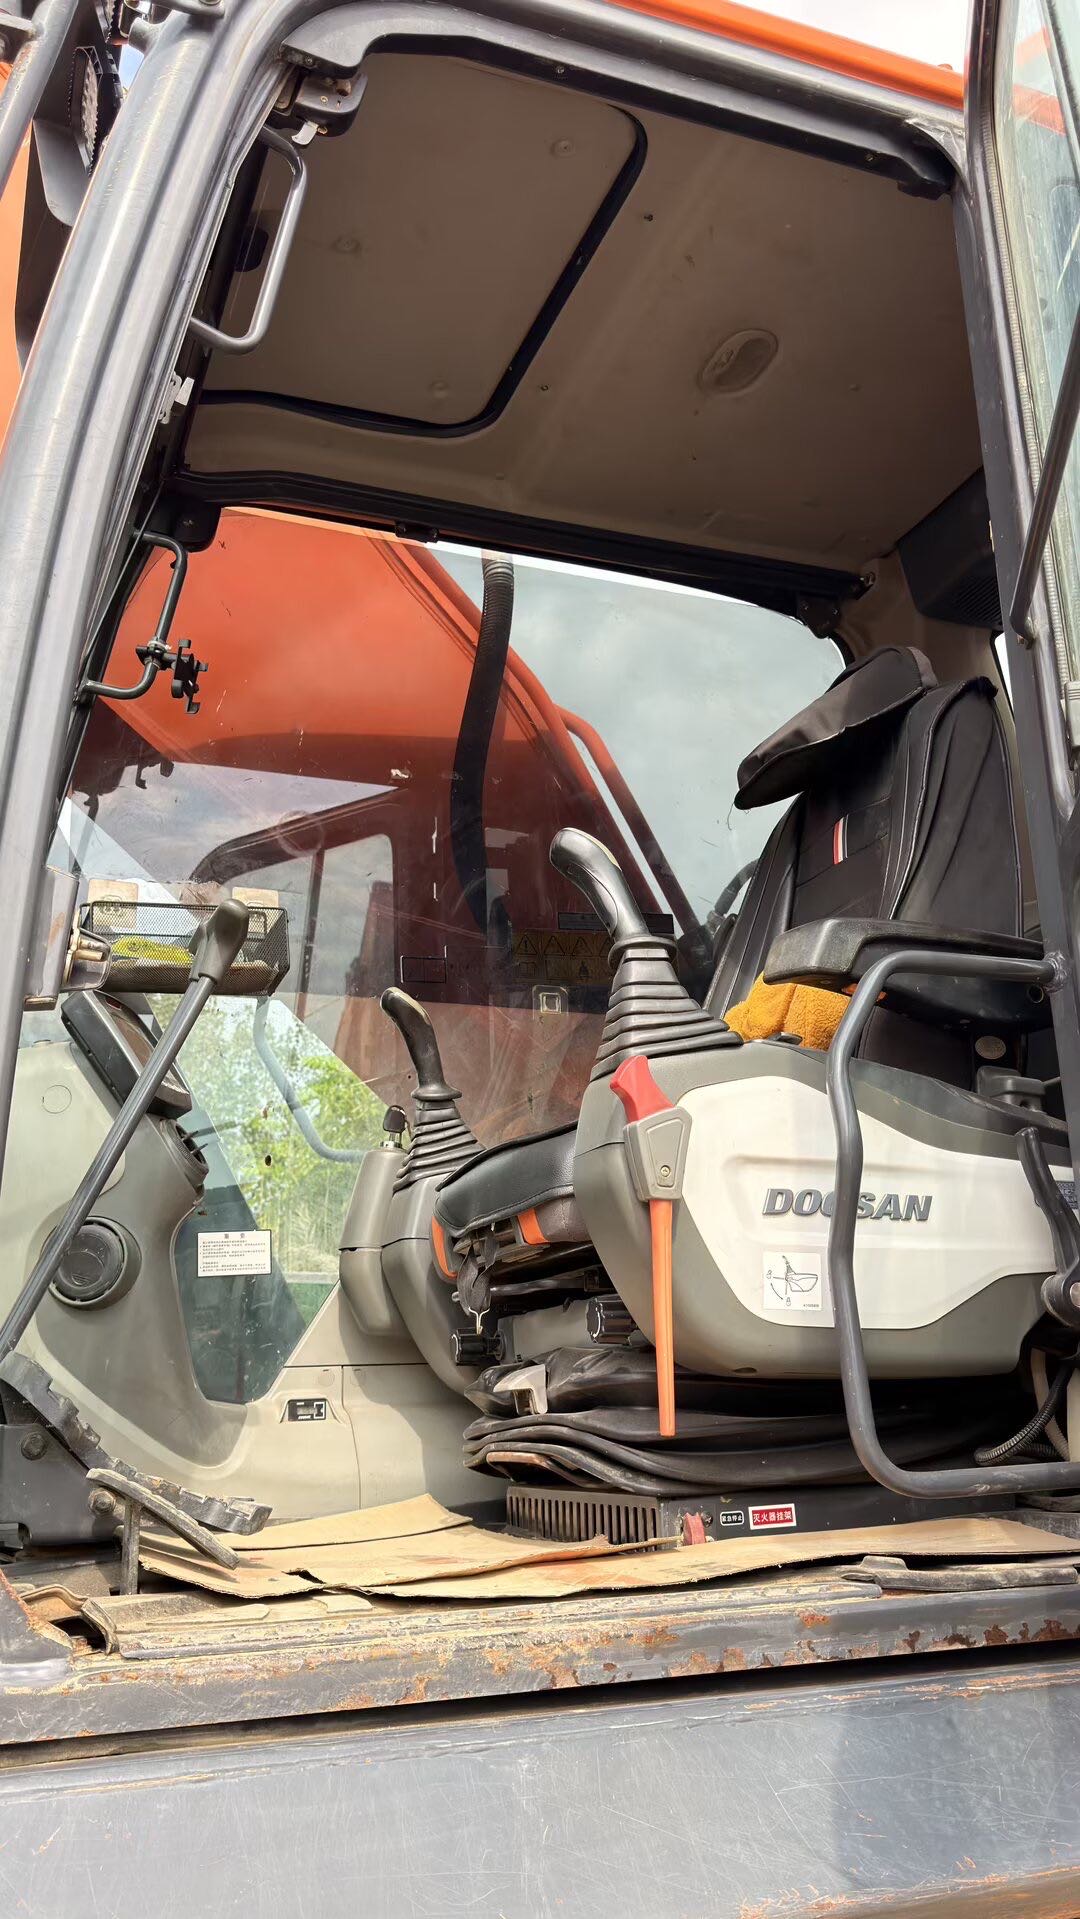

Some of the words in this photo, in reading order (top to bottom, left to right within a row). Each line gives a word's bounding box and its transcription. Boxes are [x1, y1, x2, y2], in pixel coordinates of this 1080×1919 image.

[753, 1510, 792, 1523] 灭火器挂架
